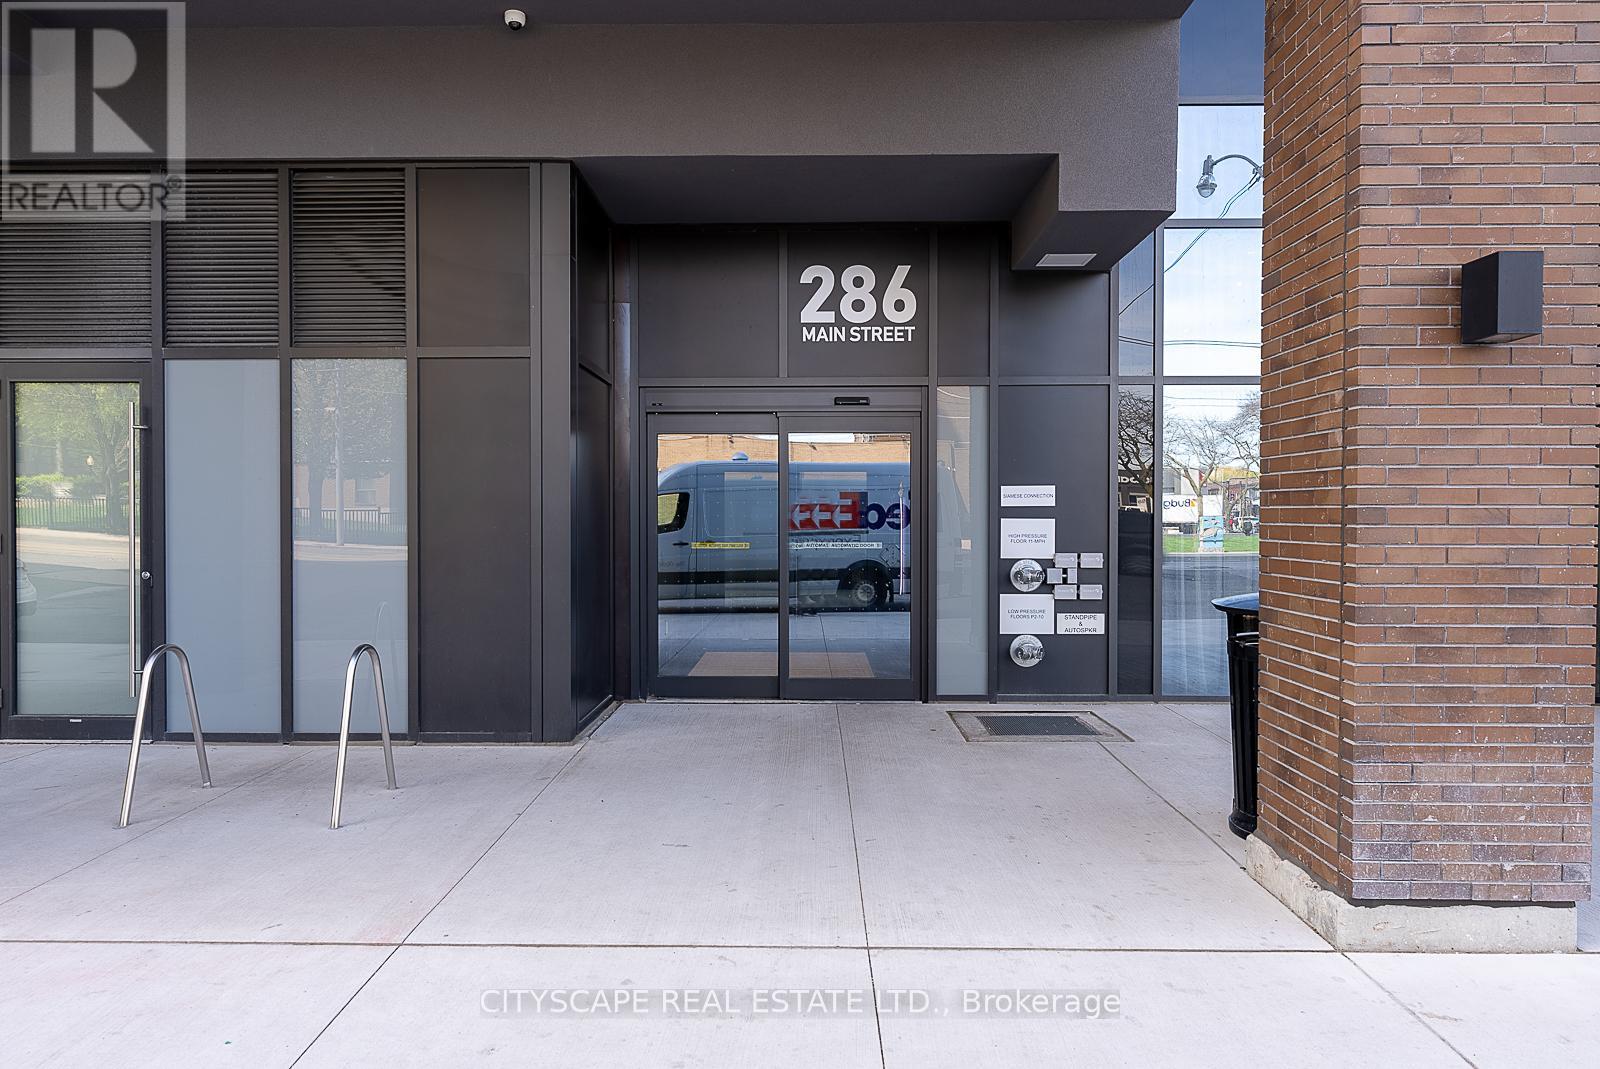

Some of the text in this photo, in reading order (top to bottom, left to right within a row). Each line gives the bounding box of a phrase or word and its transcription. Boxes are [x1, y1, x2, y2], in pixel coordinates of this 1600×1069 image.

[799, 264, 917, 324] 286
[802, 326, 916, 342] MAIN STREET
